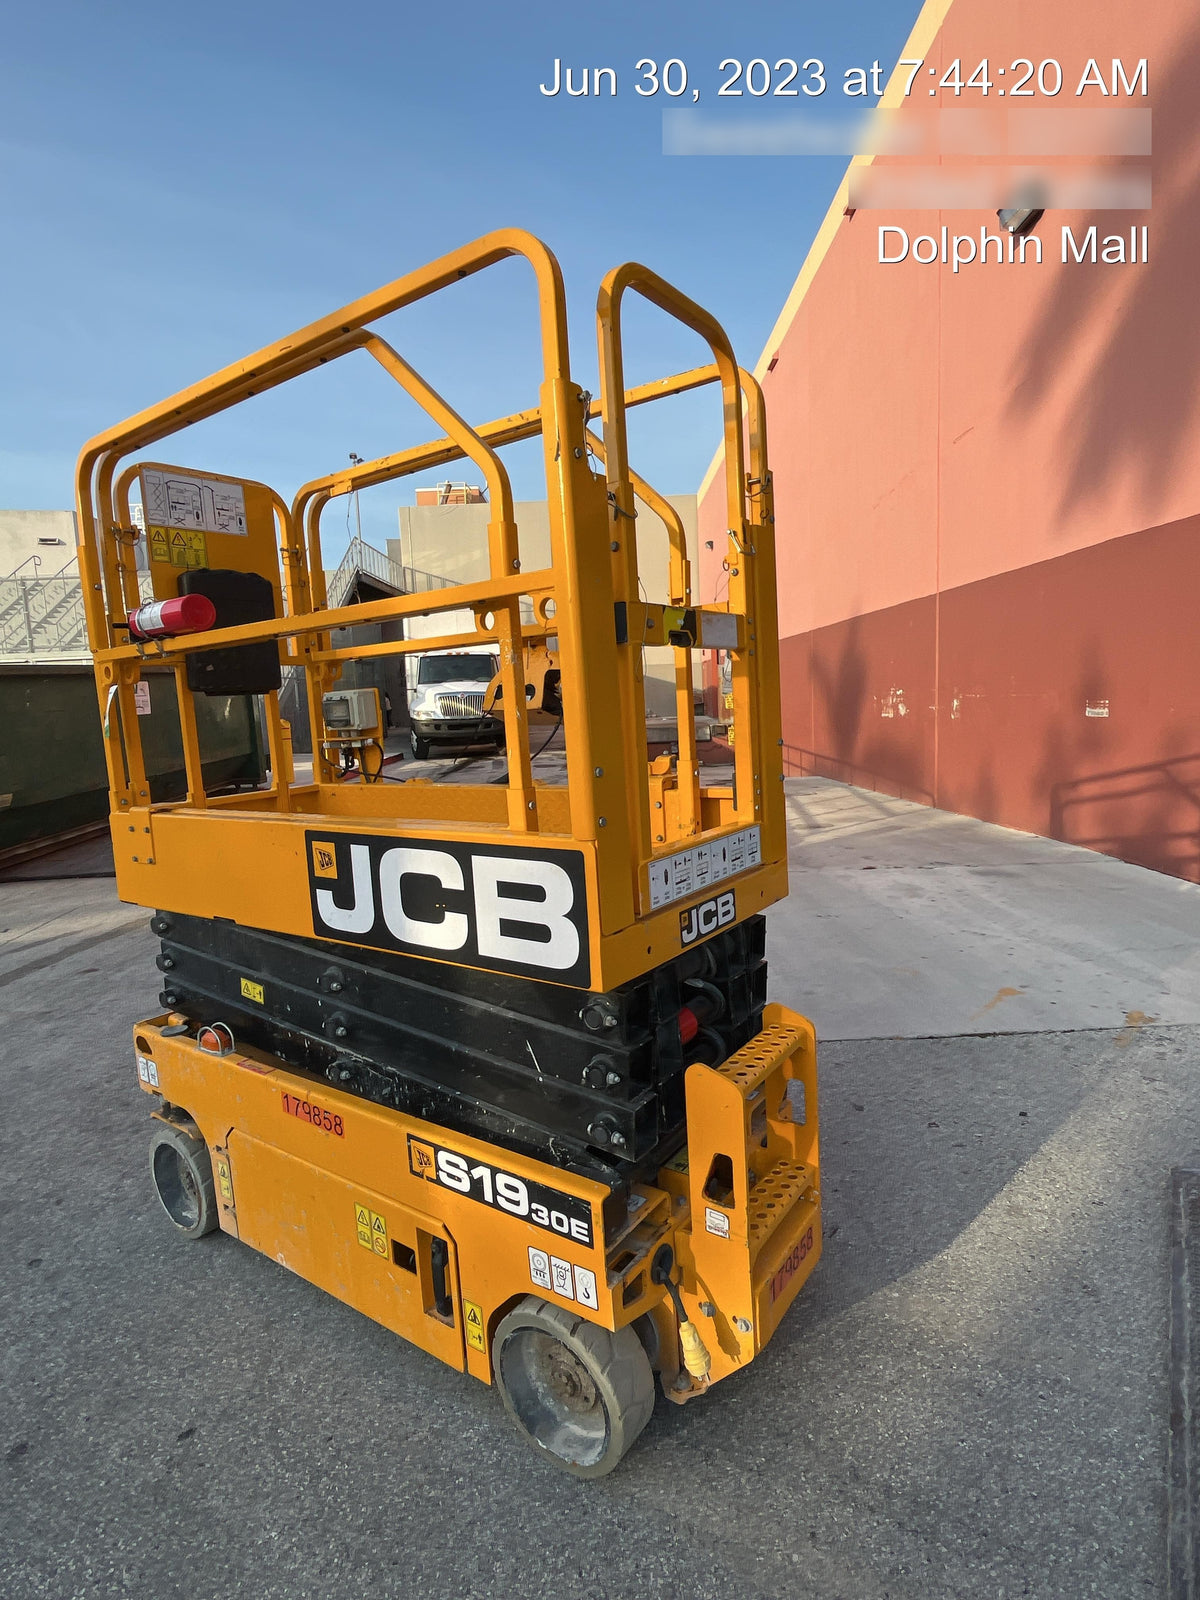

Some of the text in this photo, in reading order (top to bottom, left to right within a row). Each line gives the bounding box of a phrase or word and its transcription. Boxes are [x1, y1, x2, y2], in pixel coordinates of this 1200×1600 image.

[317, 850, 334, 868] JCB
[316, 843, 580, 970] JCB
[681, 892, 736, 944] JCB
[282, 1093, 344, 1137] 179858
[770, 1225, 814, 1303] 179858
